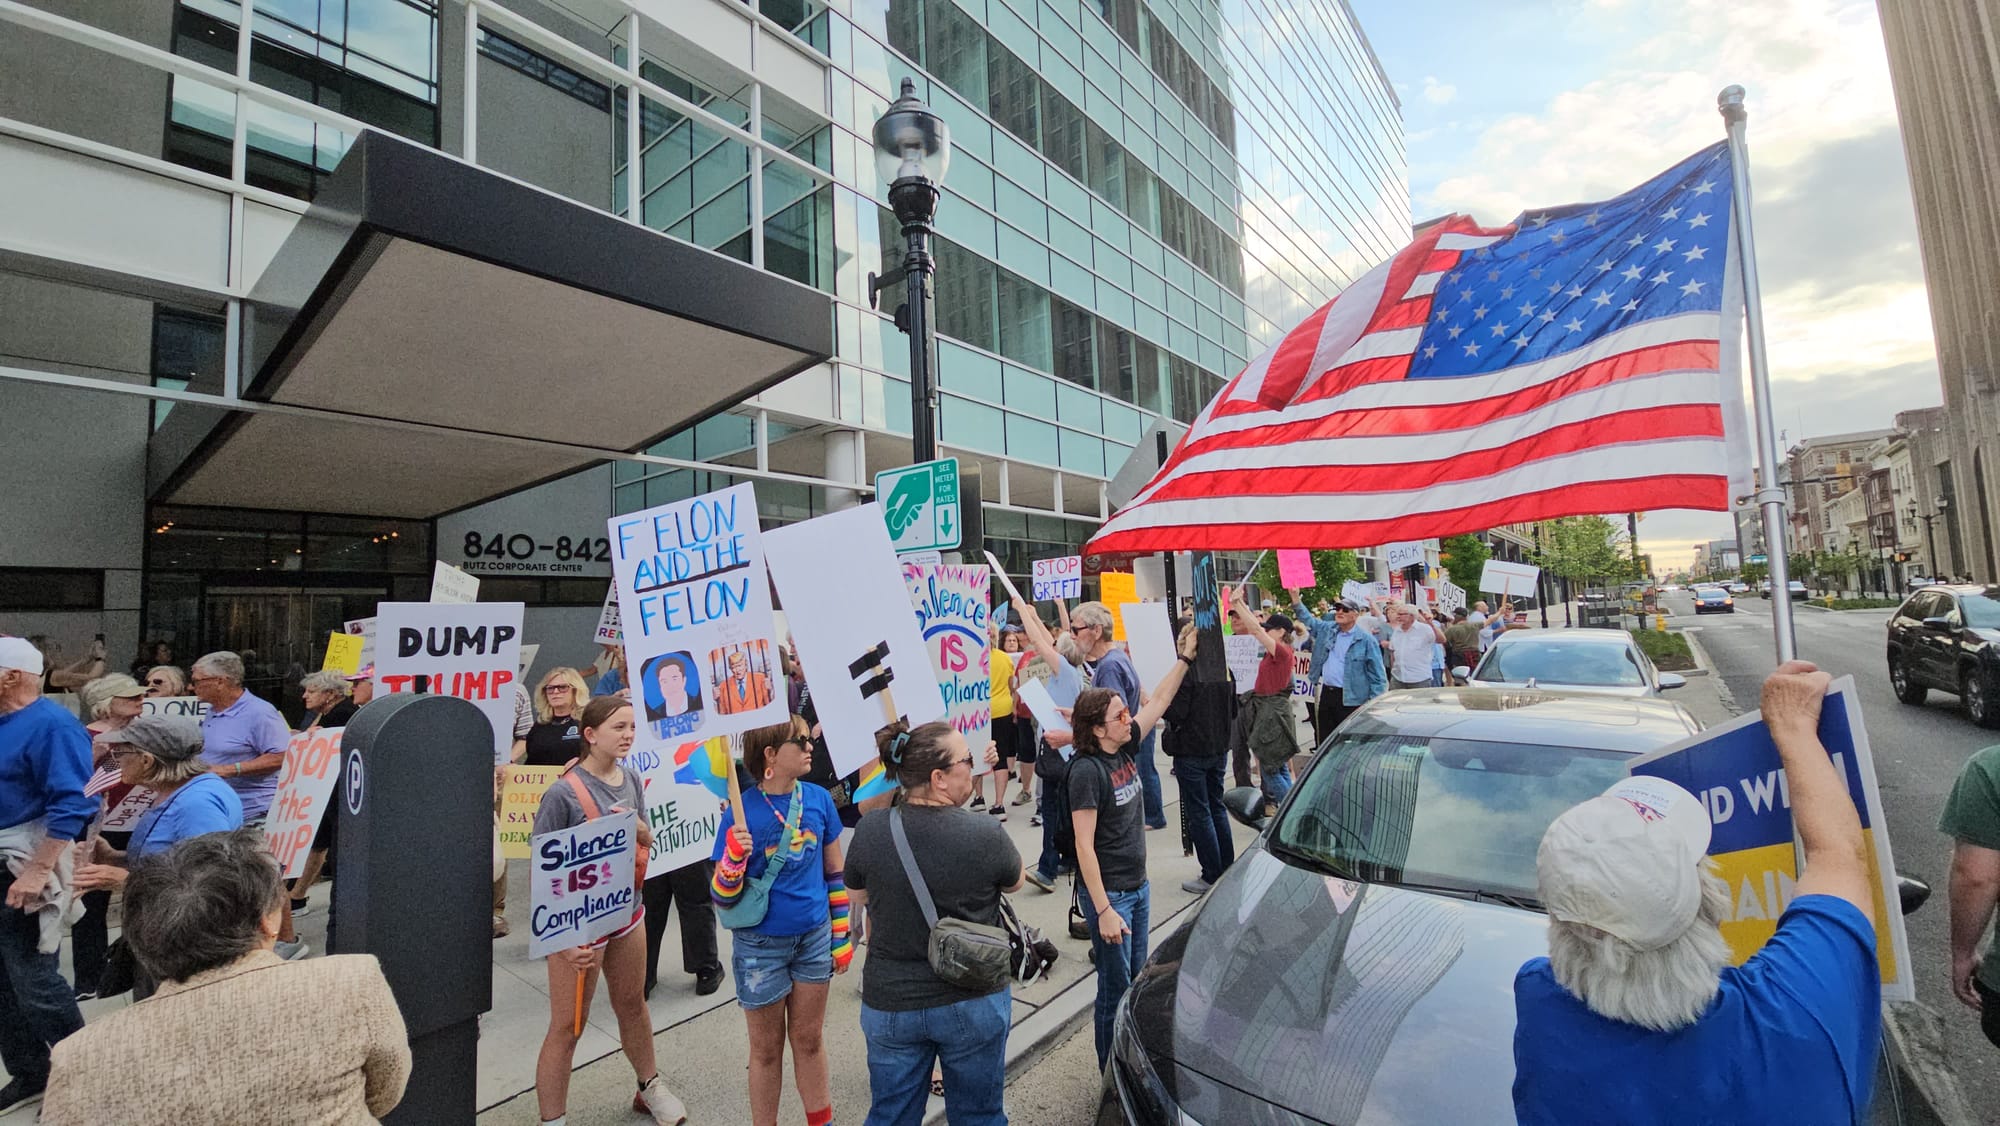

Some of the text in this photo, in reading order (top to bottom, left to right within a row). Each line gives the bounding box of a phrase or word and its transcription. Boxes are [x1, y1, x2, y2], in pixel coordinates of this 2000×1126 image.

[935, 474, 955, 484] METER
[938, 463, 950, 473] SEE
[936, 495, 956, 504] RATES
[938, 485, 952, 493] FOR
[463, 531, 611, 562] 840-842
[1389, 544, 1420, 564] BACK
[463, 561, 583, 572] BUTZ CORPORATE CENTER
[634, 551, 691, 590] AND
[692, 534, 750, 574] THE
[1036, 557, 1078, 577] STOP
[1033, 578, 1079, 600] GRIFT
[1442, 582, 1465, 605] OUST
[640, 577, 749, 636] FELON
[398, 626, 516, 658] DUMP
[940, 634, 968, 672] IS
[939, 673, 990, 716] pliance
[165, 700, 208, 716] ONE
[660, 711, 699, 728] BELONG
[674, 722, 696, 736] JAIL
[350, 760, 361, 804] P
[513, 774, 547, 785] OUT
[277, 788, 313, 823] the
[647, 800, 679, 829] HE
[541, 829, 628, 871] Silence
[568, 863, 598, 893] IS
[532, 886, 632, 937] Compliance
